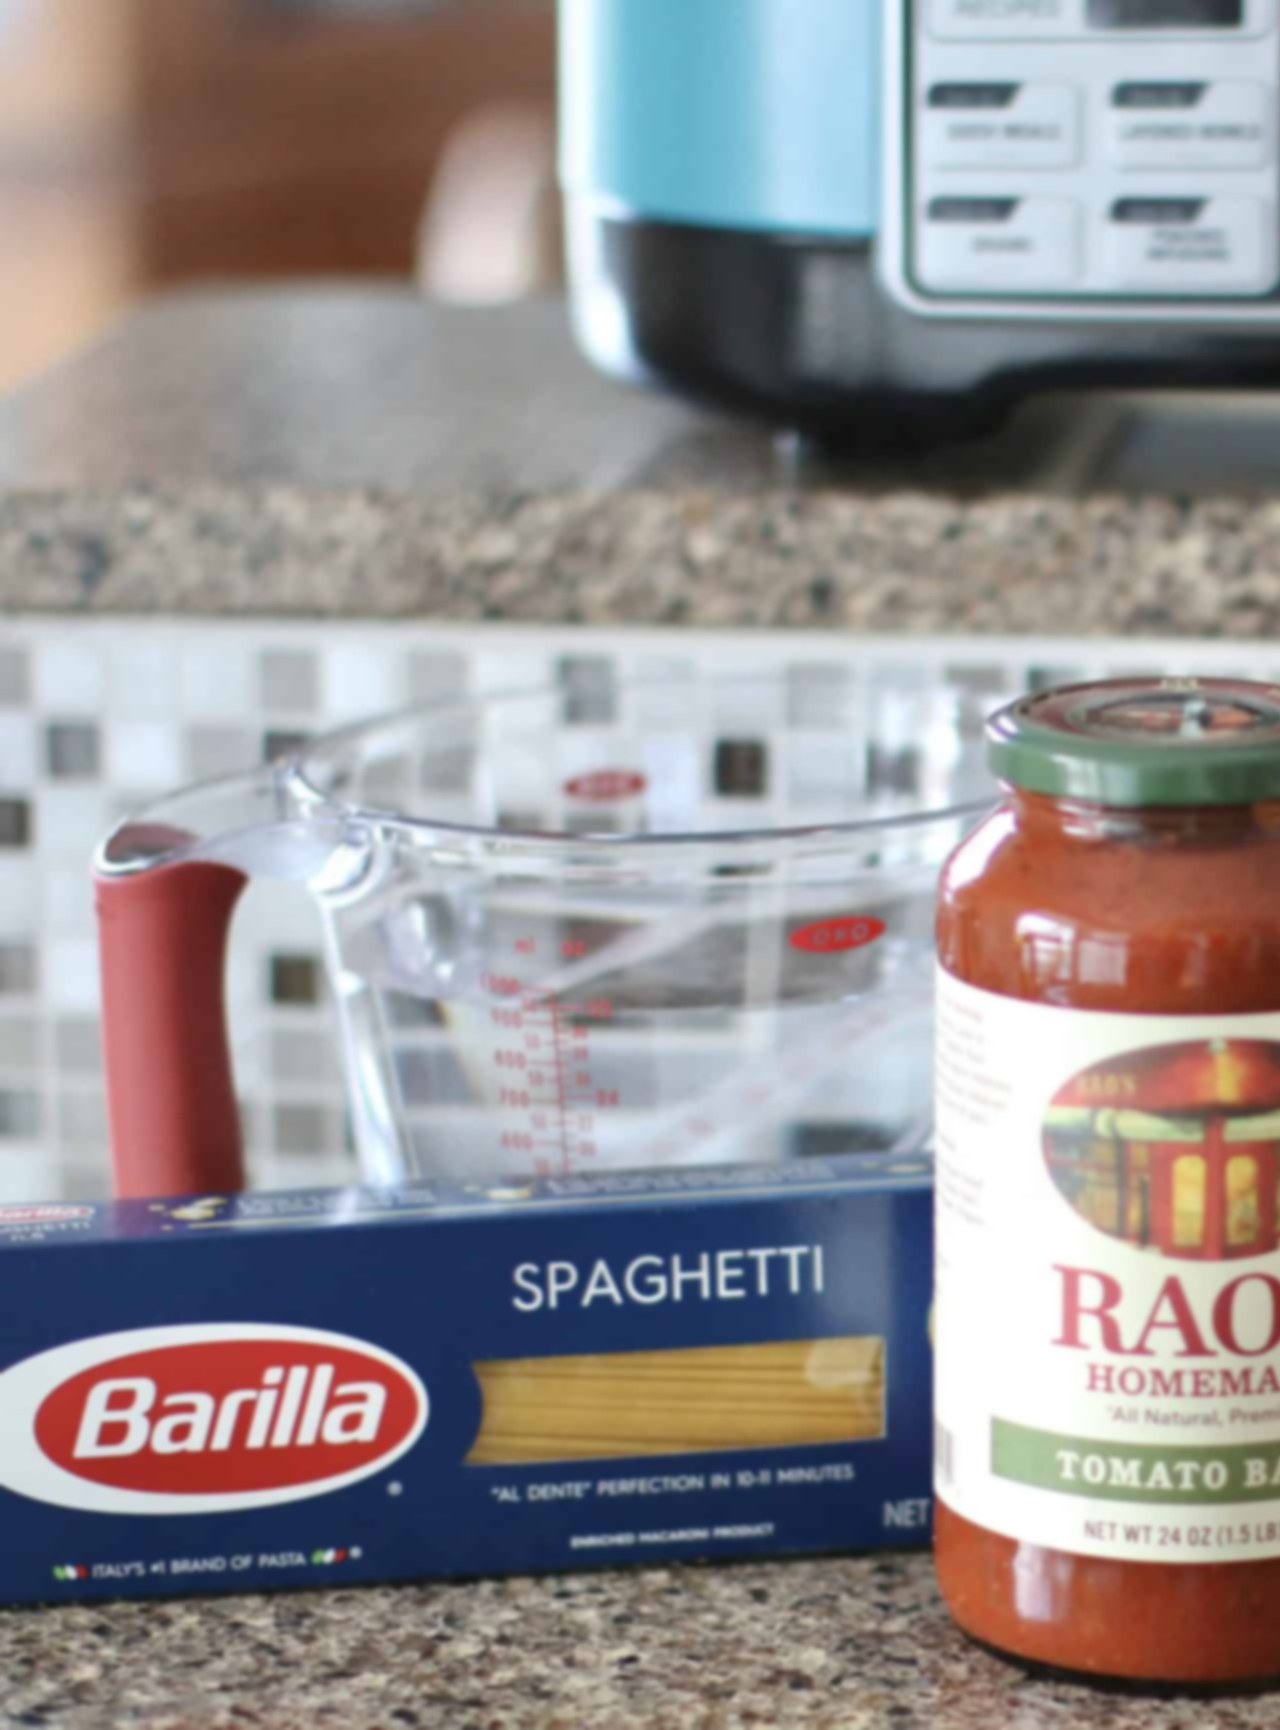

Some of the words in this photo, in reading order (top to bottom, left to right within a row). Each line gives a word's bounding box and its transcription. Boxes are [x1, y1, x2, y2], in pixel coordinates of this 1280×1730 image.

[511, 1244, 825, 1313] SPAGHETTI
[72, 1363, 388, 1461] Barilla
[597, 1474, 705, 1497] PERFECTION
[711, 1472, 731, 1489] IN
[736, 1469, 771, 1487] 10-11
[776, 1462, 855, 1485] MINUTES
[1057, 1449, 1229, 1491] TOMATO
[882, 1499, 931, 1529] NET
[569, 1531, 636, 1550] ENRICHED
[638, 1527, 710, 1545] MACARONI
[712, 1522, 776, 1540] PRODUCT
[1083, 1519, 1118, 1543] NET
[1124, 1523, 1155, 1546] WT
[1158, 1525, 1182, 1547] 24
[1187, 1524, 1212, 1546] OZ
[1217, 1521, 1251, 1547] (1.5
[91, 1560, 145, 1579] ITALY'S
[170, 1556, 227, 1575] BRAND
[230, 1554, 253, 1570] OF
[257, 1551, 307, 1568] PASTA
